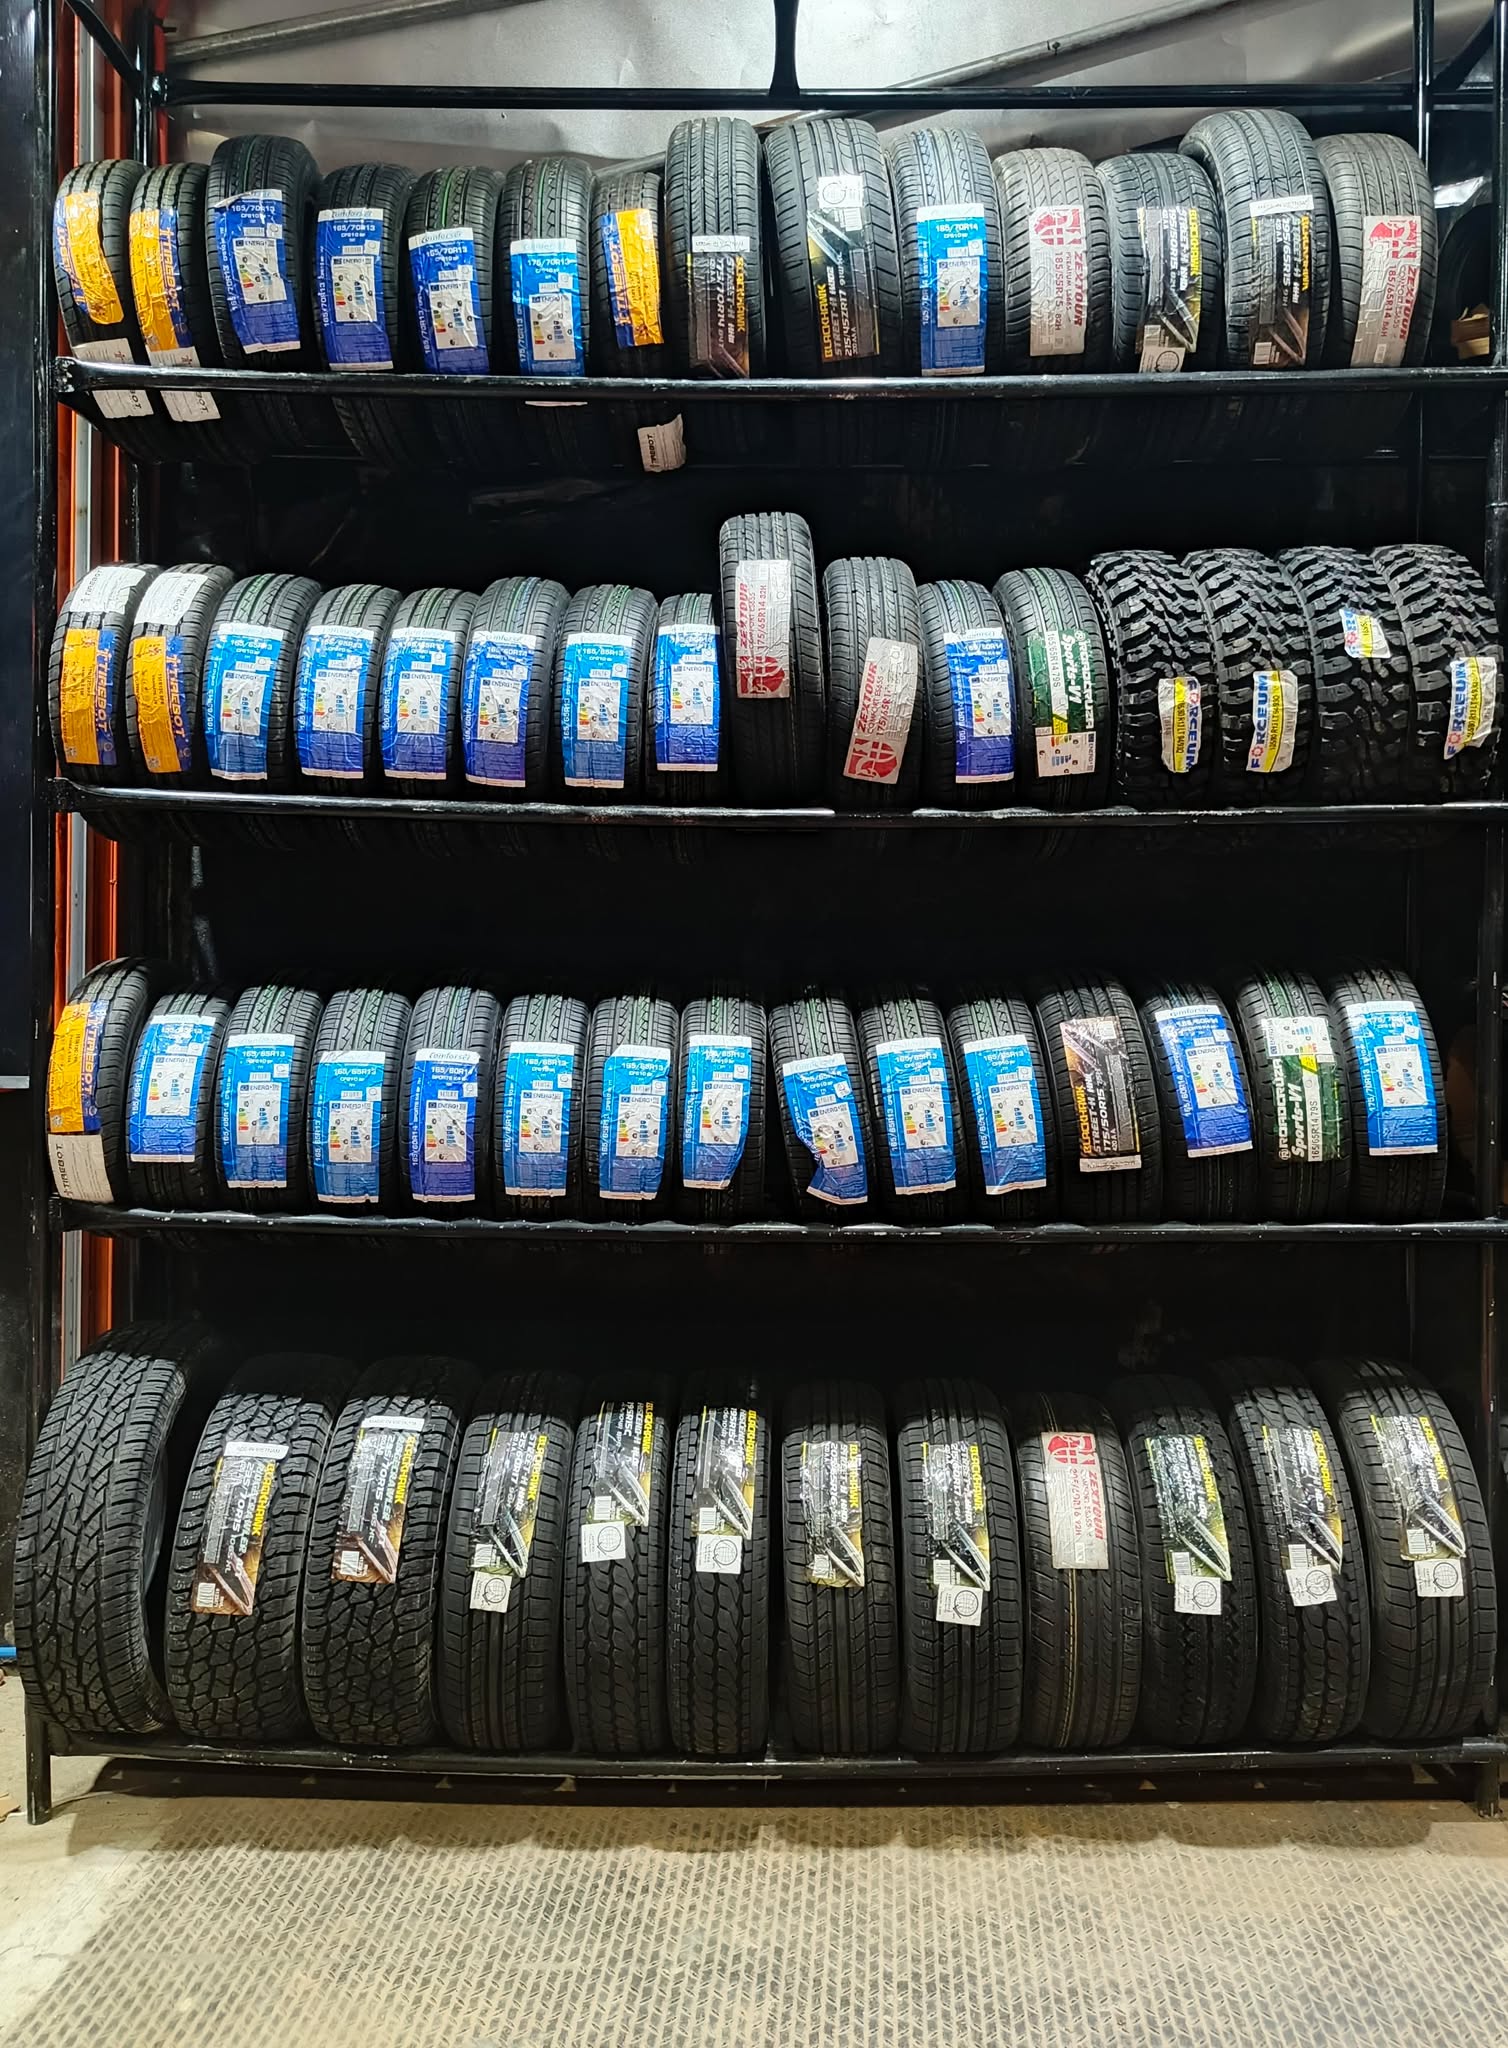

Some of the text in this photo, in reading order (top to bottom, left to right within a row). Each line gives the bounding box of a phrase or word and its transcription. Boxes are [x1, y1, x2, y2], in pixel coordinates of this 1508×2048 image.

[162, 240, 180, 313] TIREBOT
[609, 240, 630, 314] TIREBOT
[1281, 218, 1290, 288] 195/65R15
[816, 283, 833, 358] BLACKHAWK
[840, 289, 853, 356] 215/45ZR17
[1074, 252, 1083, 327] ZEXTOUR
[739, 583, 748, 649] ZEXTOUR
[97, 661, 108, 732] TIREBOT
[166, 669, 186, 737] TIREBOT
[857, 661, 878, 733] ZEXTOUR
[1062, 633, 1082, 704] Sports-V1
[876, 686, 892, 736] 175/65R1
[1186, 679, 1201, 768] FORCEUM
[1251, 675, 1269, 768] FORCEUM
[1448, 661, 1467, 755] FORCEUM
[1075, 1085, 1092, 1154] BLACKHAWK
[1098, 1089, 1111, 1152] 175/50R15
[1288, 1083, 1304, 1158] Sports-V1
[55, 1143, 70, 1188] TIREBOT
[745, 1410, 757, 1465] BLACKHAWK
[252, 1461, 275, 1537] BLACKHAWK
